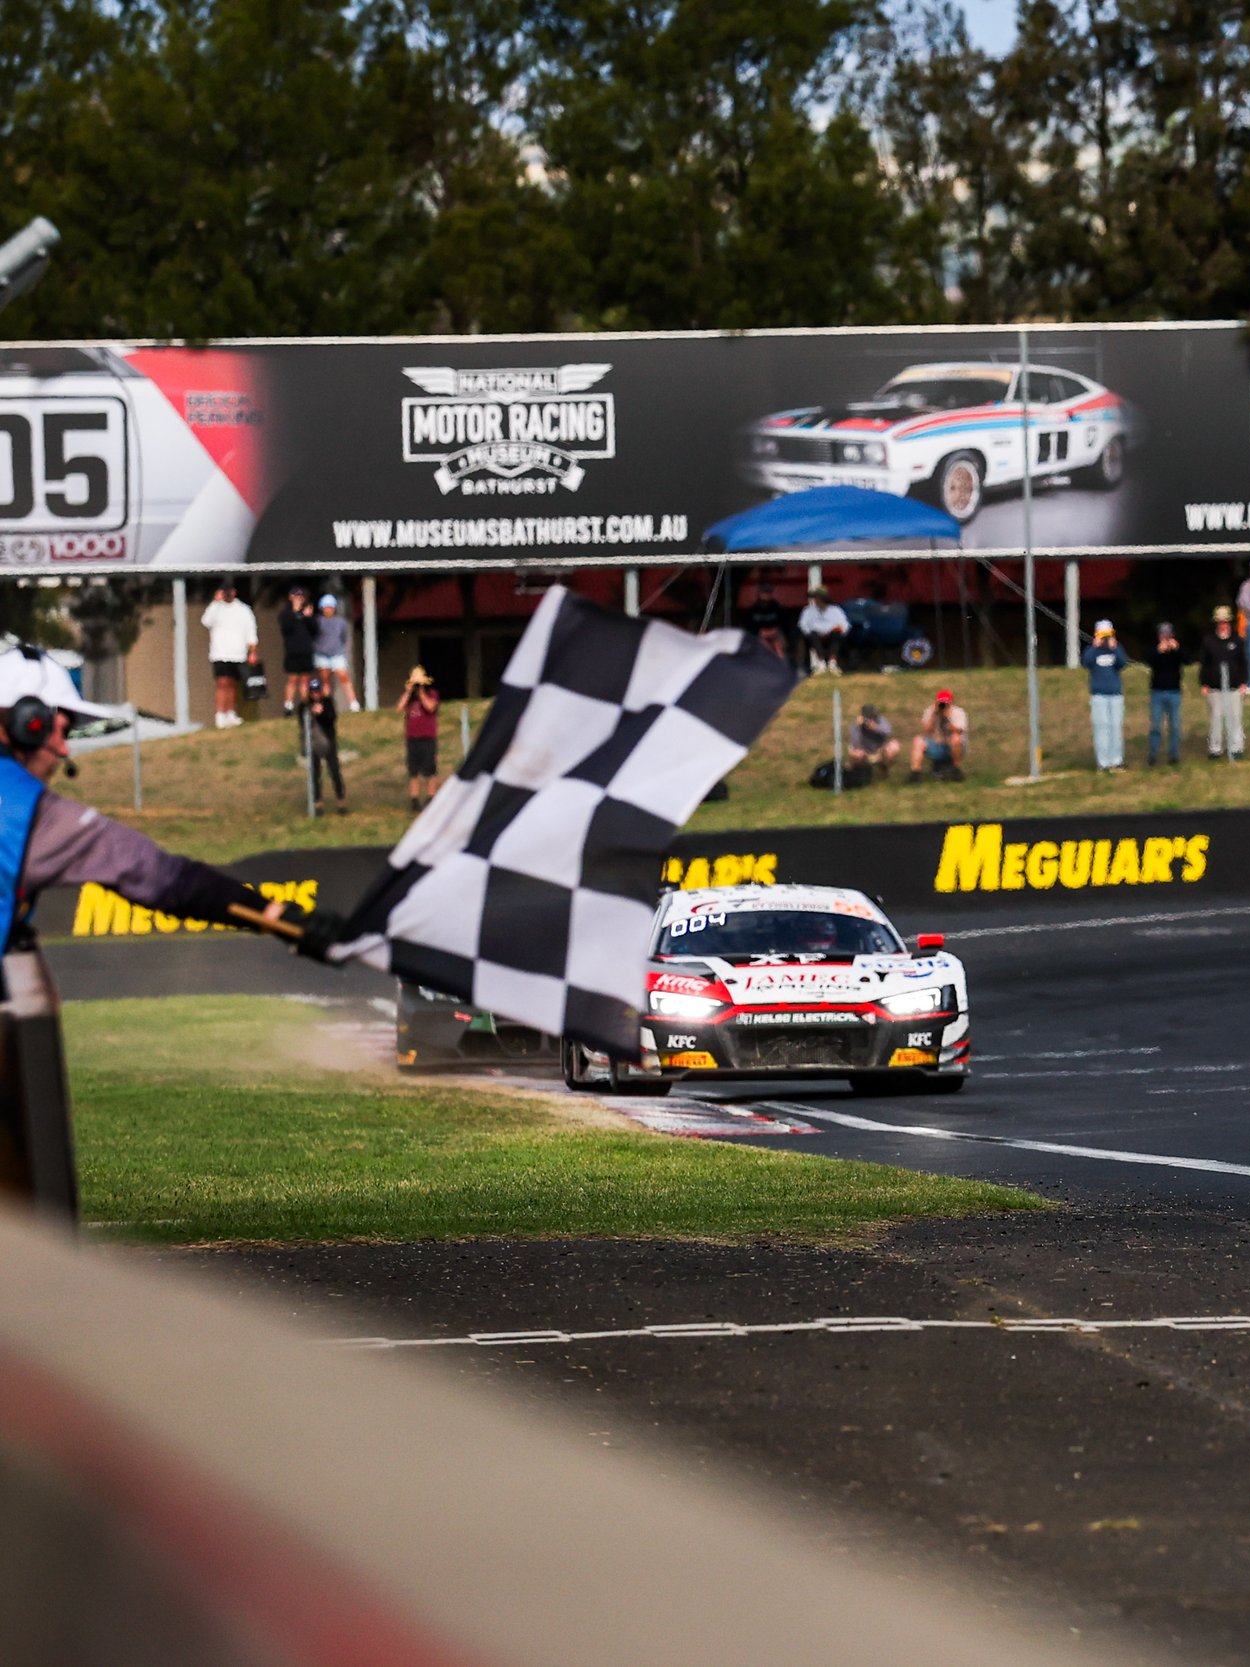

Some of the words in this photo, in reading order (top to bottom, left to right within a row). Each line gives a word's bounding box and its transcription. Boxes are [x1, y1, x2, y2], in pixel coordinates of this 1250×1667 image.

[460, 373, 556, 392] NATIONAL
[413, 404, 504, 444] MOTOR
[509, 402, 604, 442] RACING
[466, 447, 551, 467] MUSEUM
[461, 478, 557, 495] BATHURST
[333, 515, 689, 549] WWW.MUSEUMSBATHURST.COM.AU
[671, 911, 727, 938] 004
[667, 1034, 697, 1049] KFC
[908, 1031, 932, 1048] KFC
